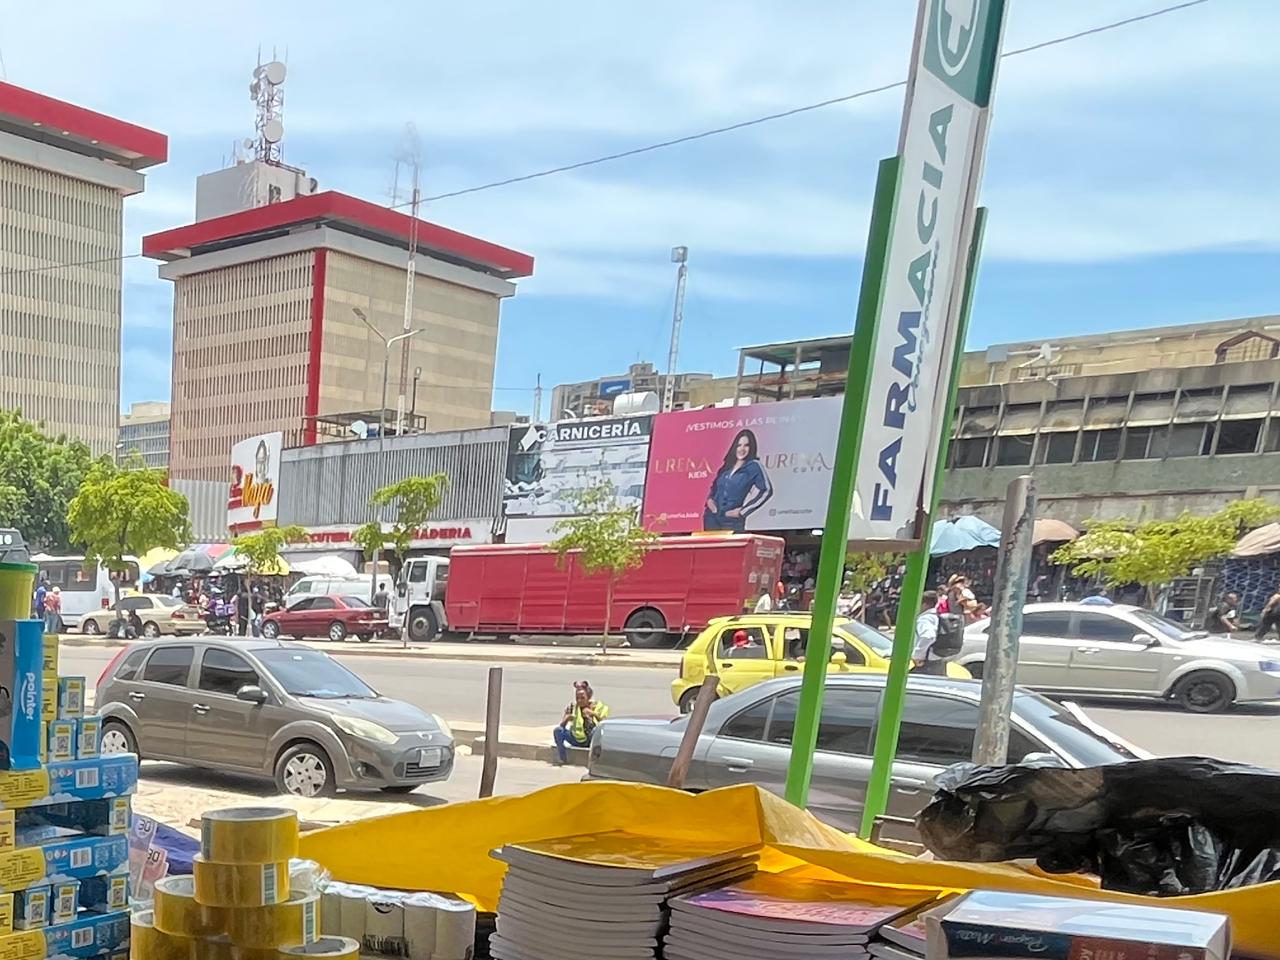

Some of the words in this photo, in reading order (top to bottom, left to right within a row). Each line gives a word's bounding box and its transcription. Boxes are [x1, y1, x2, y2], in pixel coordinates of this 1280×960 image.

[870, 104, 954, 522] FARMACIA
[536, 421, 642, 443] CARNICERÍA
[745, 417, 764, 426] LAS
[25, 672, 36, 721] painter
[138, 819, 151, 832] 30
